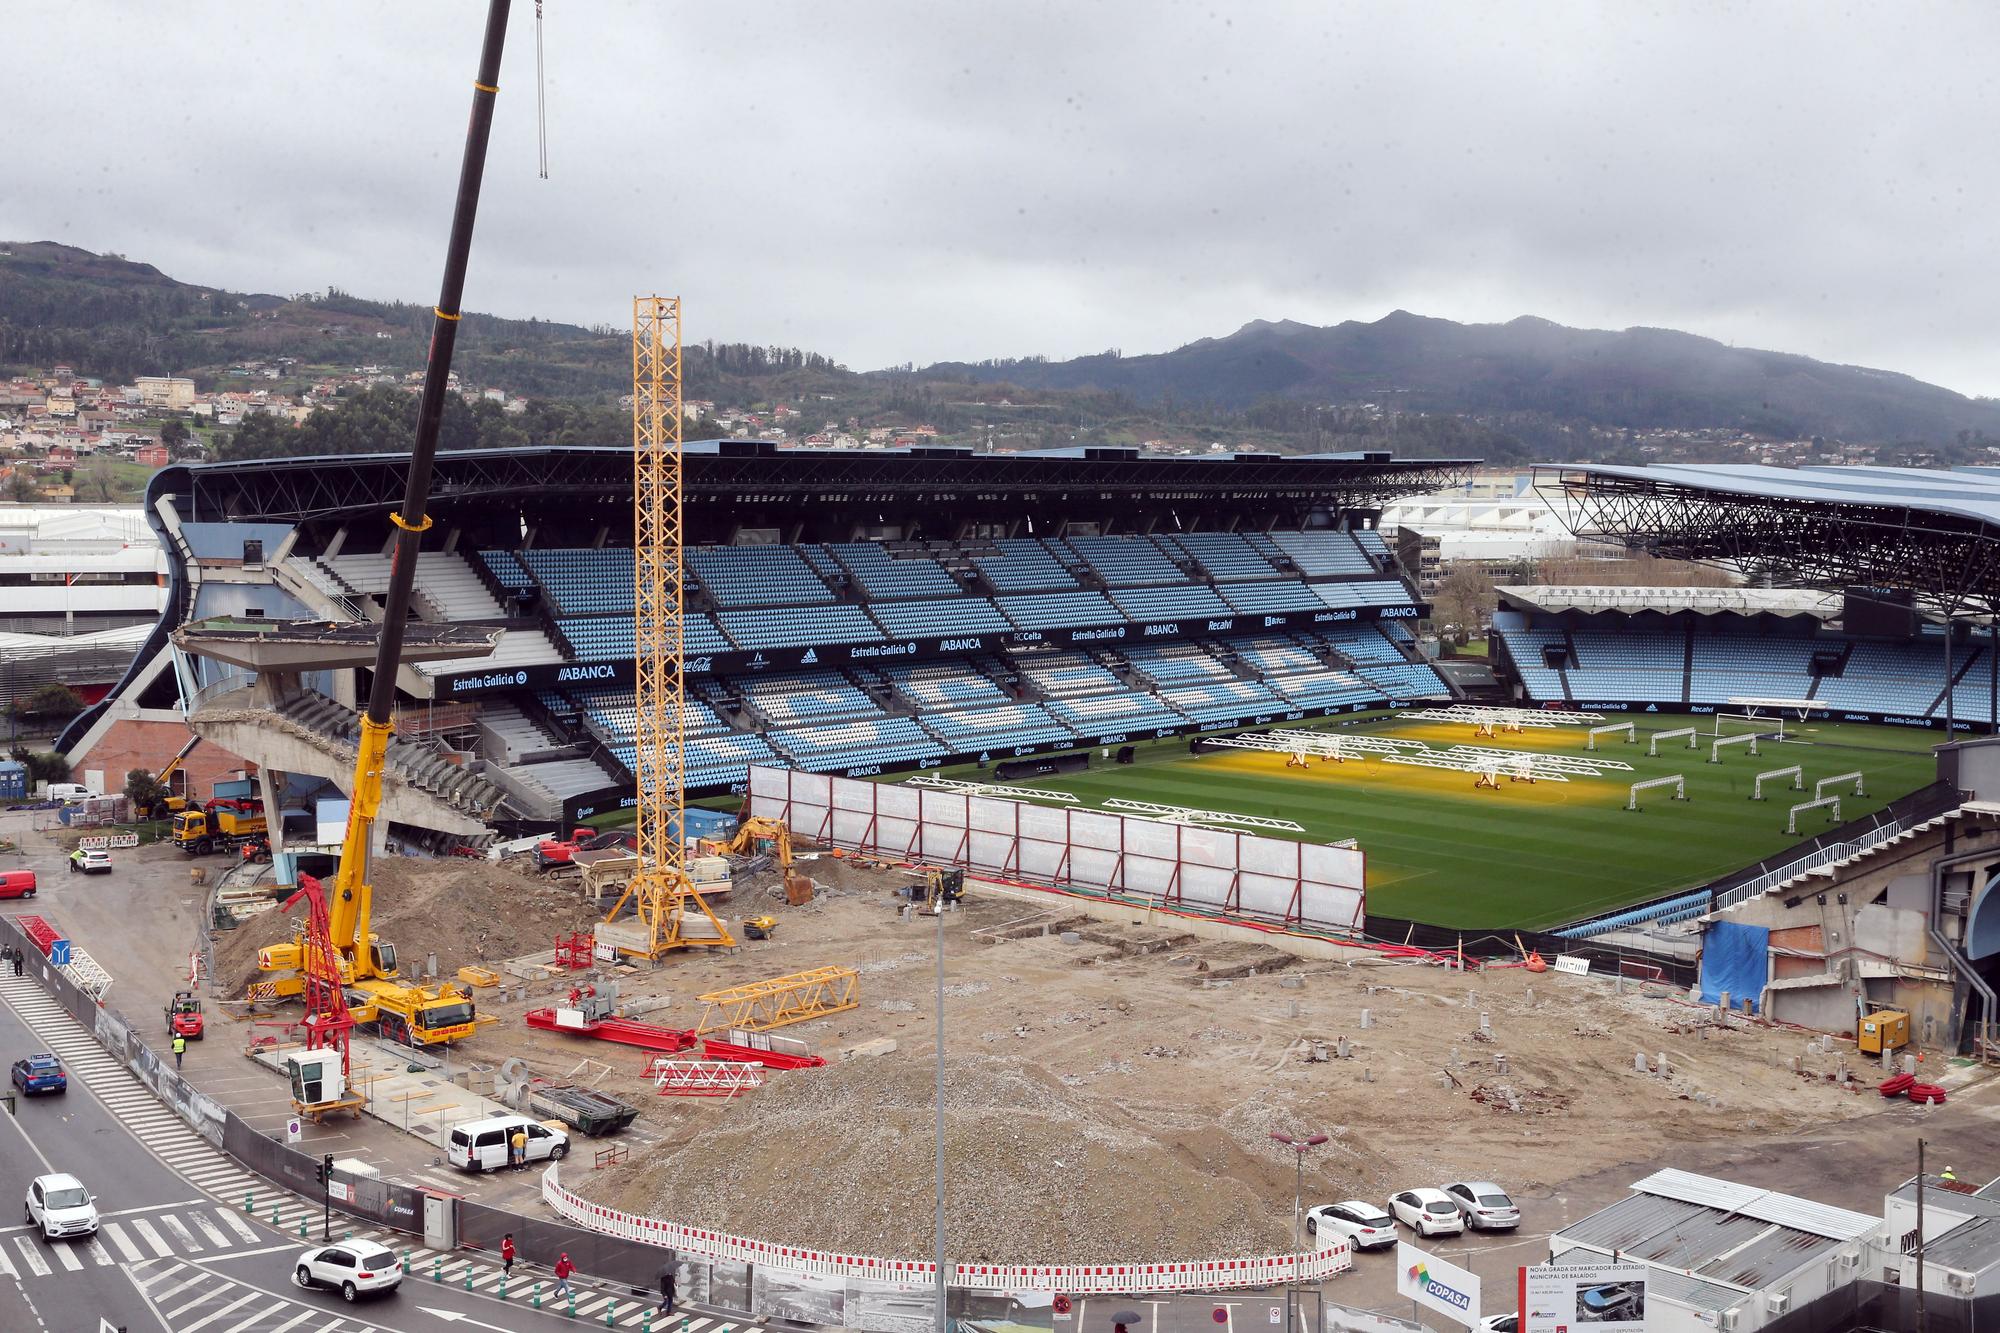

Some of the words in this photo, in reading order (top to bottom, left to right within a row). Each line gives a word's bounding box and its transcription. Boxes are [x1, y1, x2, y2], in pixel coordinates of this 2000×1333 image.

[1072, 630, 1095, 641] Estrella
[851, 647, 879, 658] Estrella
[880, 644, 906, 655] Galicia
[453, 679, 482, 692] Estrella
[483, 673, 514, 687] Galicia
[394, 1206, 414, 1216] COPASA
[1428, 1281, 1468, 1309] COPASA
